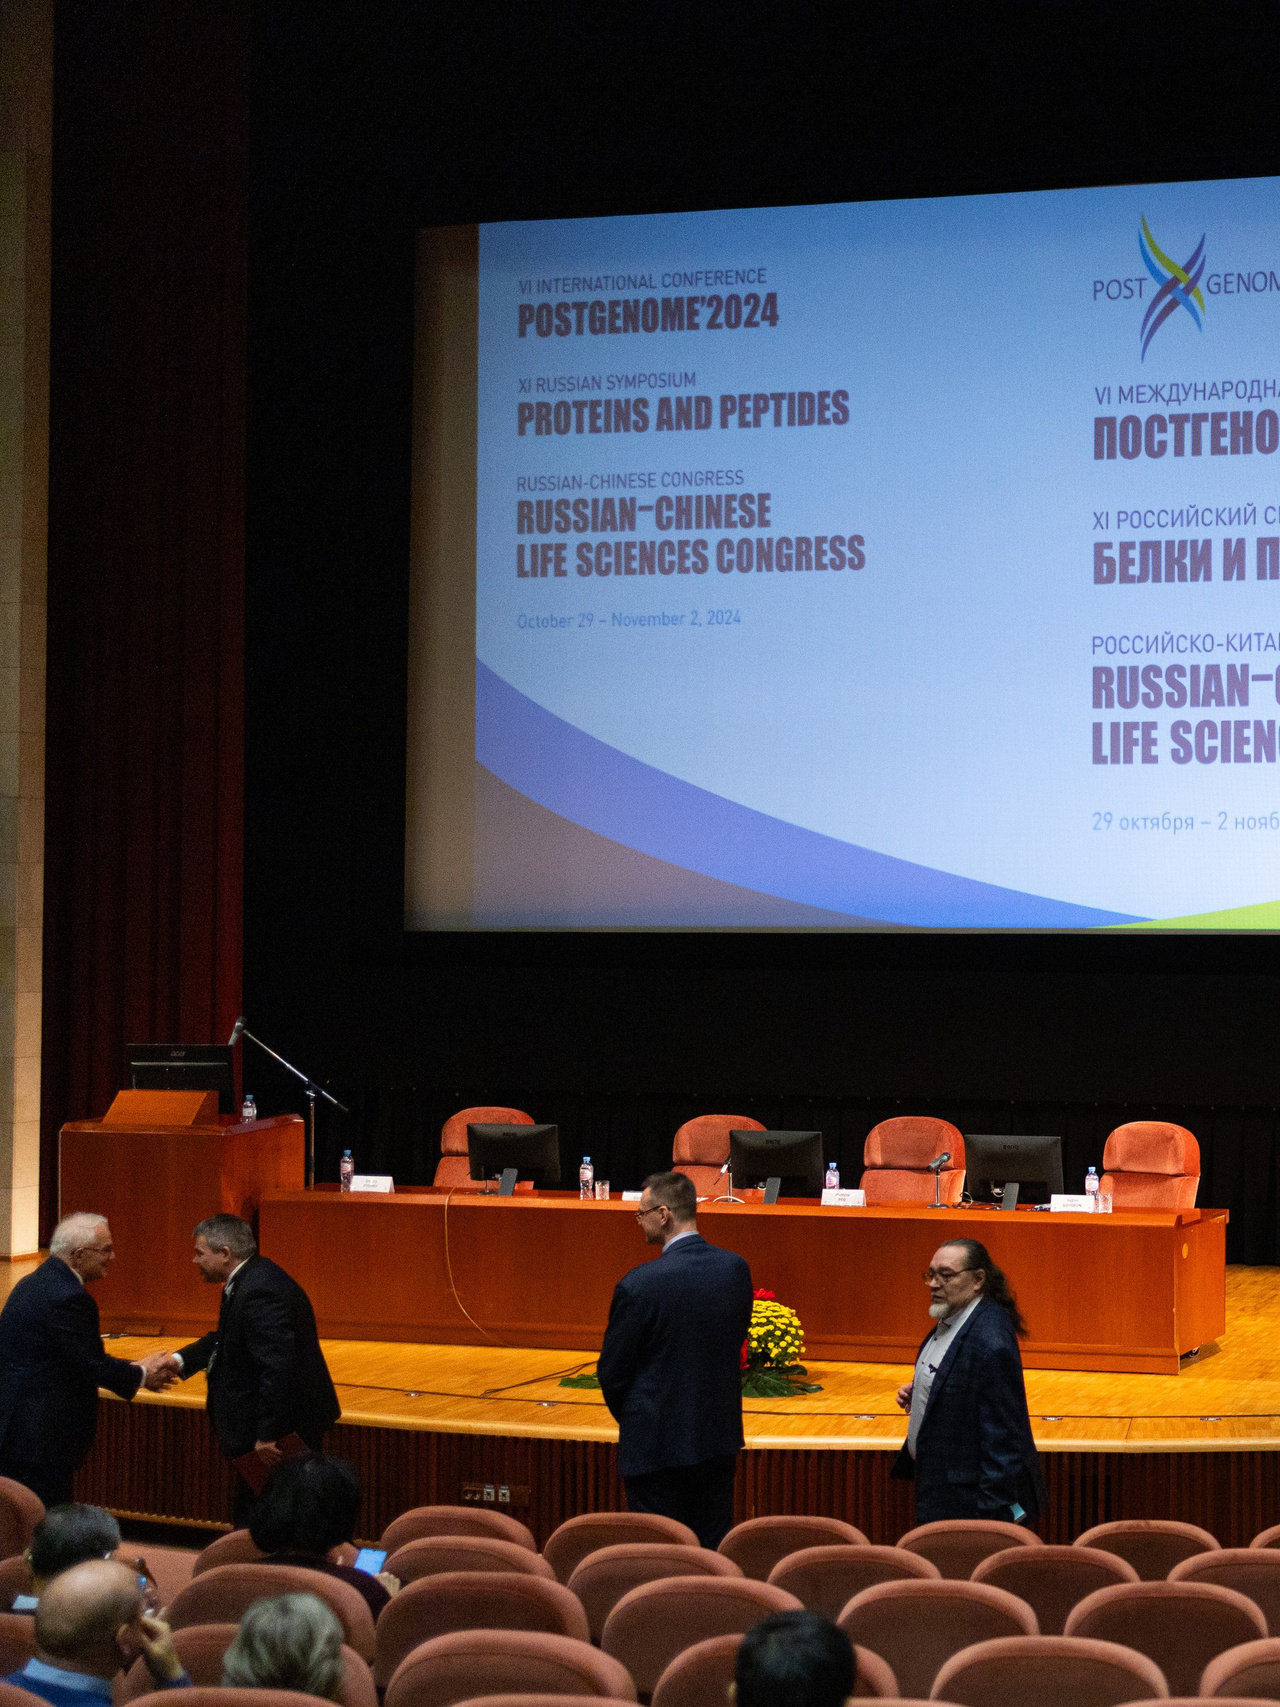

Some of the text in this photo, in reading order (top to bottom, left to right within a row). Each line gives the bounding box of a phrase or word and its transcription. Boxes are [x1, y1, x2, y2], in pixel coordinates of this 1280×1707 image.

[519, 268, 767, 295] VI INTERNATIONAL CONFERENCE
[1092, 277, 1147, 301] POST
[518, 372, 696, 393] XI RUSSIAN SYMPOSIUM
[1095, 386, 1111, 405] VI
[518, 390, 850, 436] PROTEINS AND PEPTIDES
[517, 470, 744, 492] RUSSIAN-CHINESE CONGRESS
[1093, 511, 1110, 531] XI
[1117, 504, 1257, 530] РОССИЙСКИЙ
[517, 534, 866, 578] LIFE SCIENCES CONGRESS
[1094, 539, 1212, 585] БЕЛКИ
[1223, 538, 1246, 581] И
[518, 613, 572, 629] October
[578, 613, 594, 628] 29
[612, 611, 686, 627] November
[707, 609, 741, 625] 2024
[1092, 722, 1158, 765] LIFE
[1092, 812, 1113, 831] 29
[1119, 812, 1194, 834] октября
[1218, 812, 1227, 830] 2
